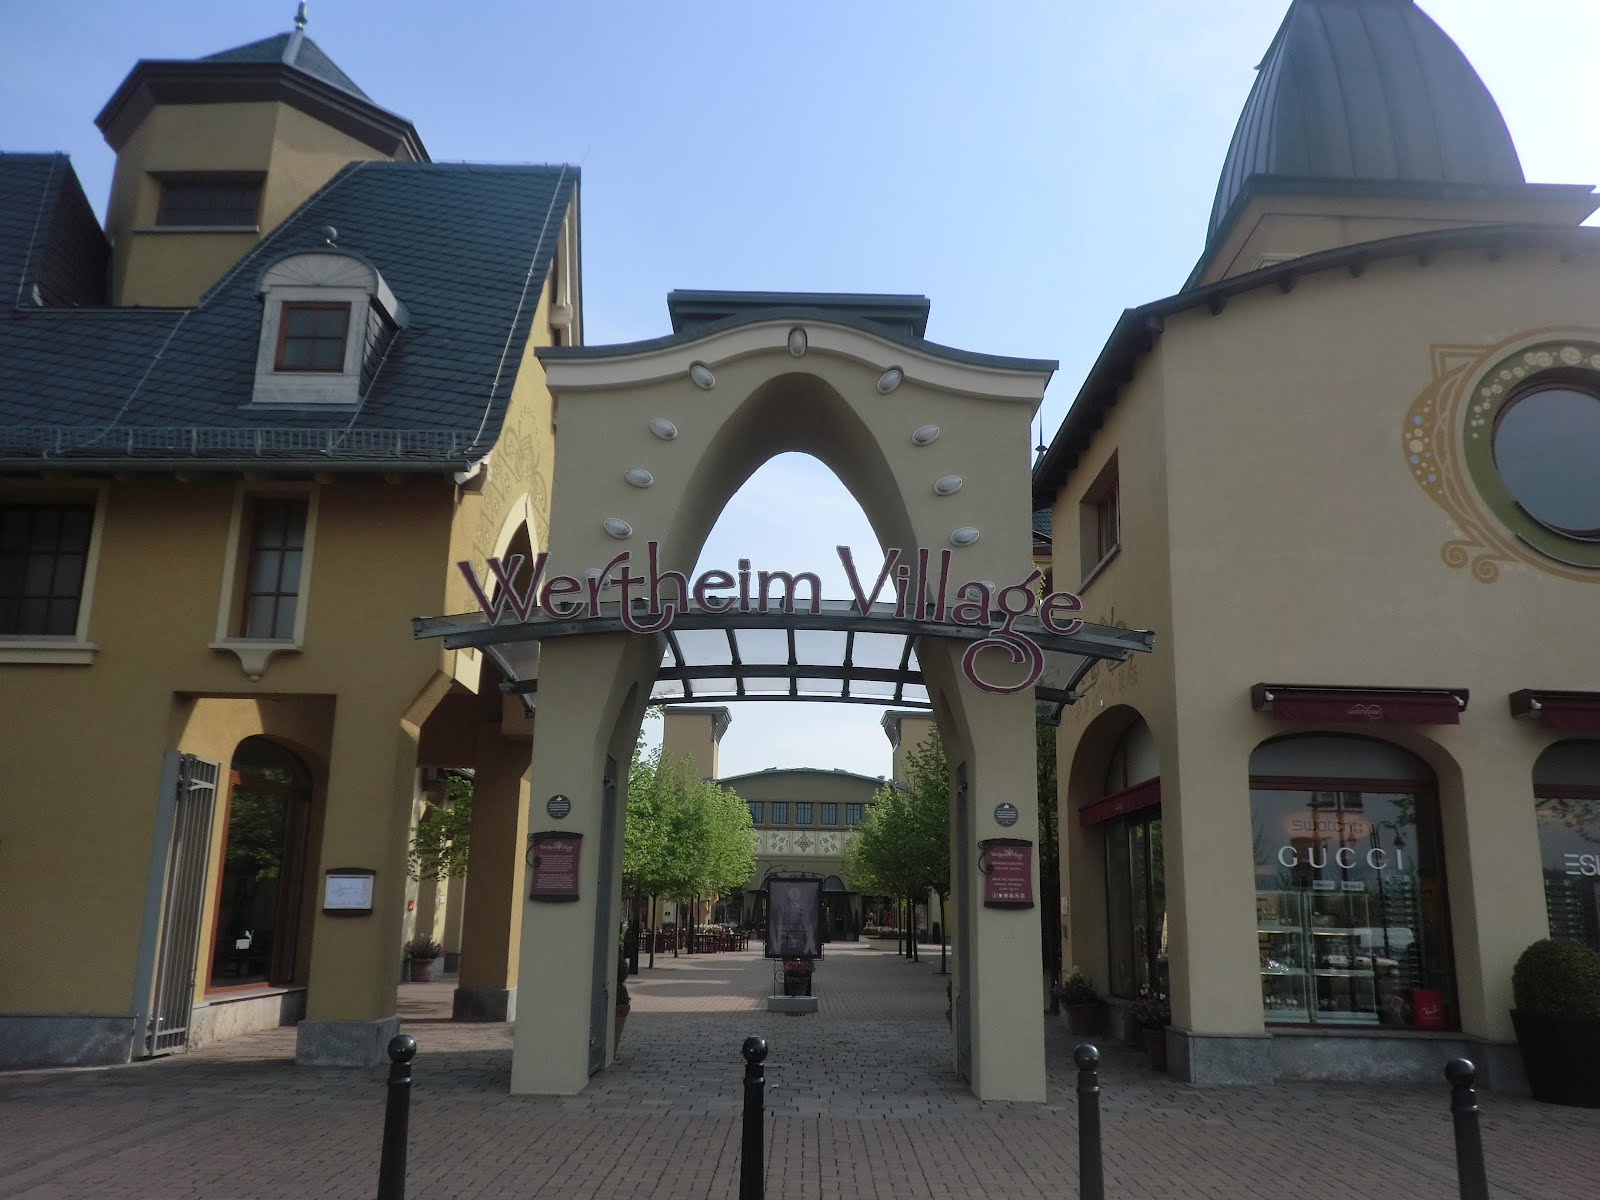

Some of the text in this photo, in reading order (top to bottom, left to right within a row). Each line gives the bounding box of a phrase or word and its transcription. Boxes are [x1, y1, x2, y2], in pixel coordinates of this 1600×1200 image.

[456, 541, 1083, 693] Wertheim Village
[1278, 846, 1403, 869] GUCCI
